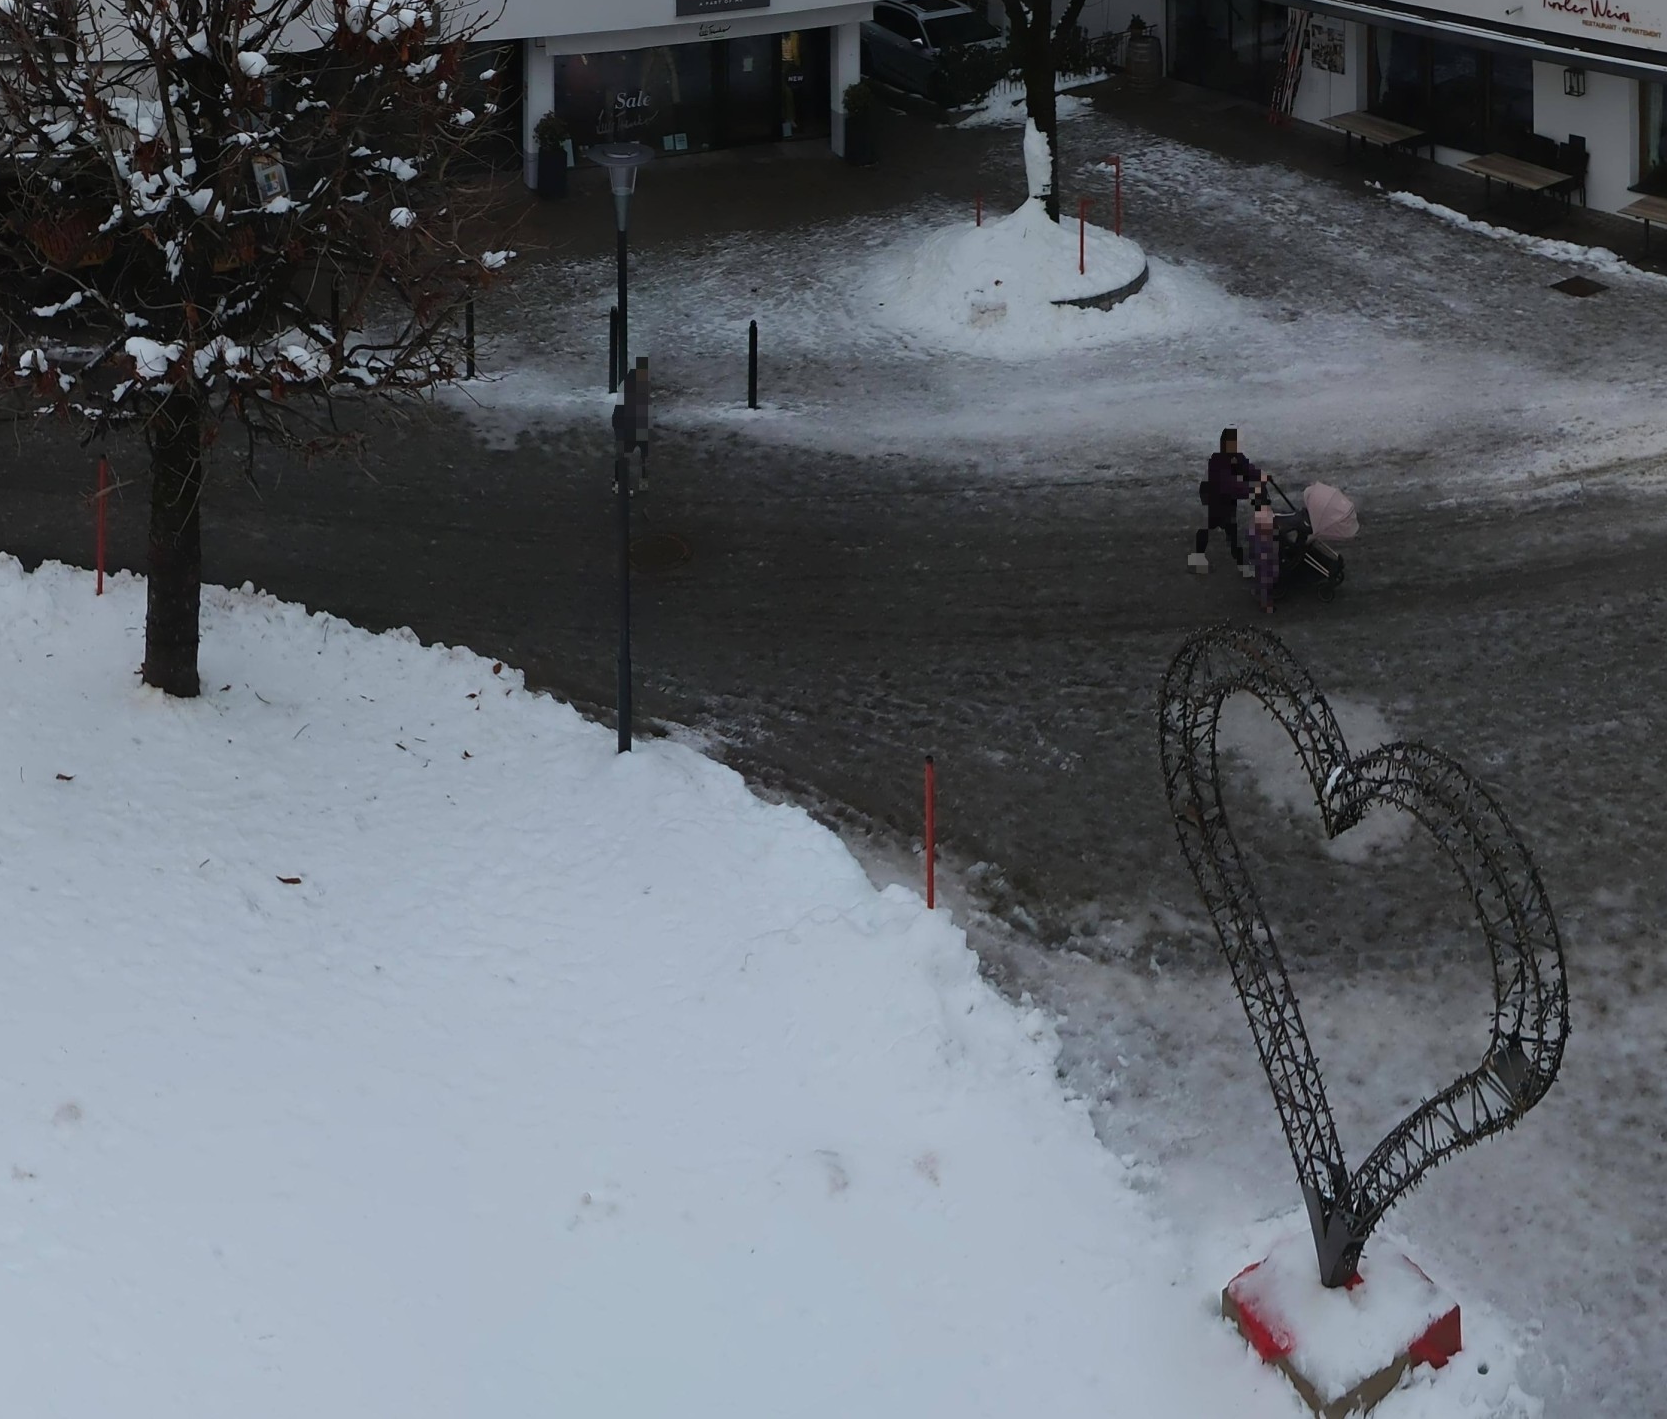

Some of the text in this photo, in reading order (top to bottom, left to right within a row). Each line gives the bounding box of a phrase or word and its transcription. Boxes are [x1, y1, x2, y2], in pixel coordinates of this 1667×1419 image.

[1581, 19, 1662, 39] RESTAURANT APPARTEMENT
[615, 90, 652, 109] Sale
